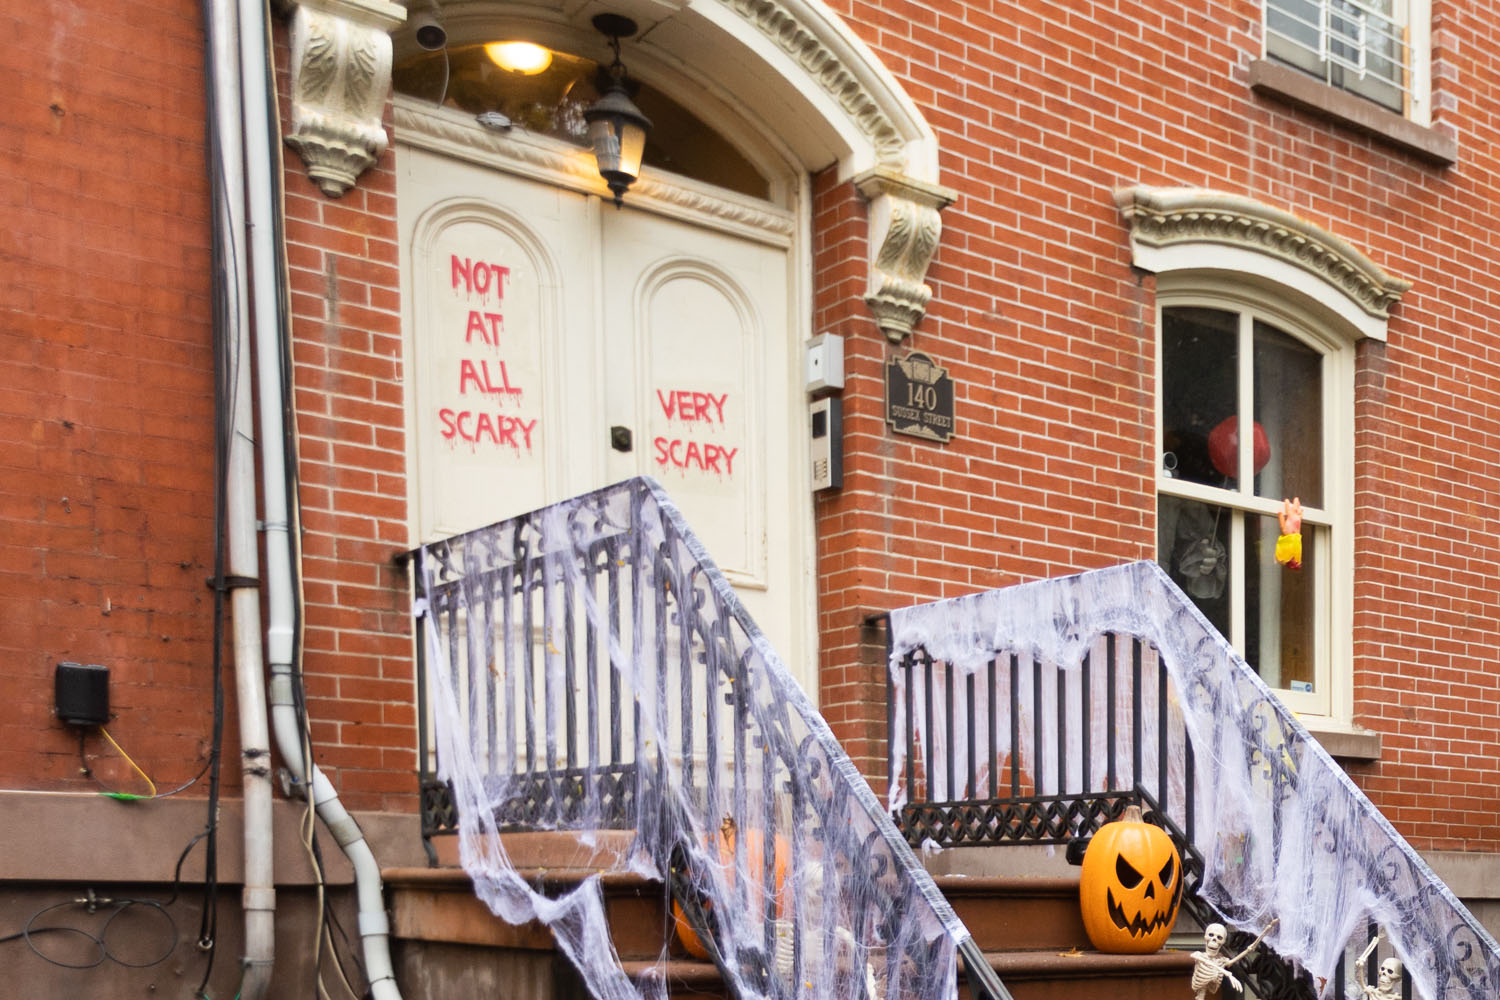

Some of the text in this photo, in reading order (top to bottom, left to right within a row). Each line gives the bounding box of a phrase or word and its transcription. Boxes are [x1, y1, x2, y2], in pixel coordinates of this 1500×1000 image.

[451, 254, 510, 300] NOT
[466, 310, 503, 347] AT
[460, 359, 522, 394] ALL
[656, 388, 728, 423] VERY
[907, 382, 937, 411] 140
[439, 408, 536, 449] SCARY
[923, 411, 951, 428] STREET
[654, 436, 738, 475] SCARY
